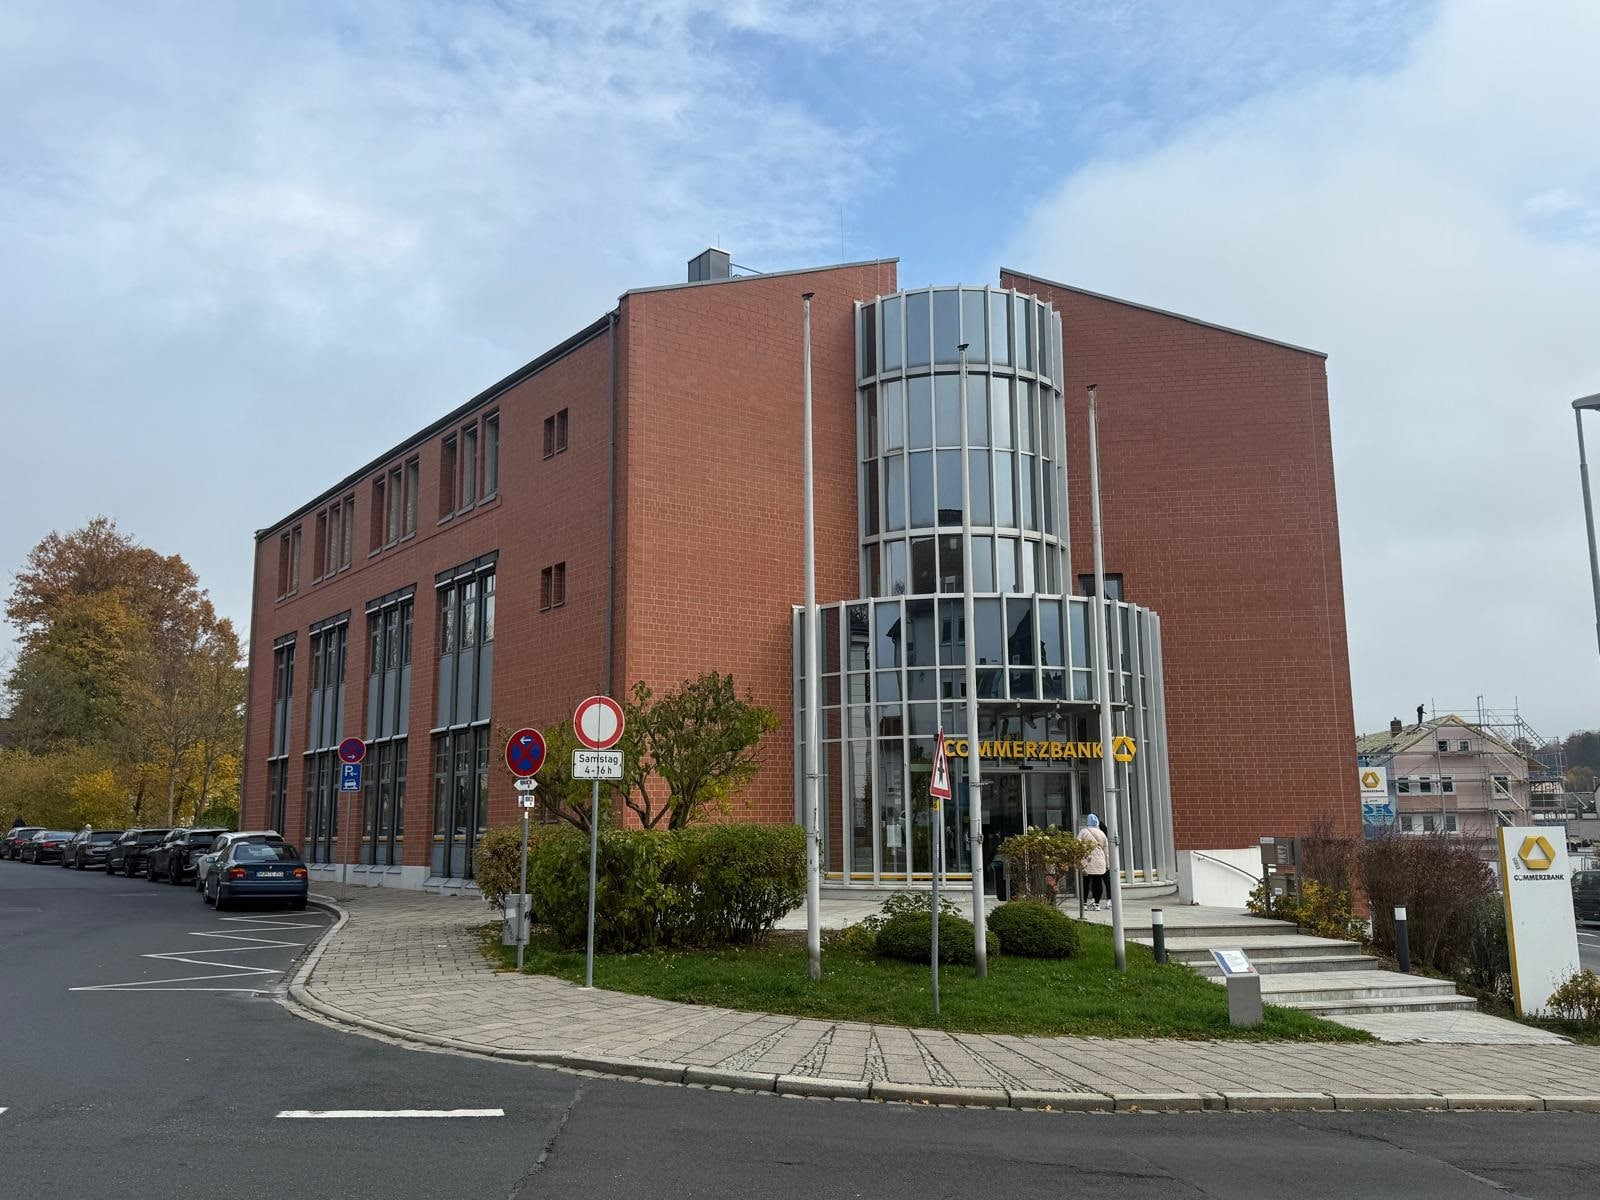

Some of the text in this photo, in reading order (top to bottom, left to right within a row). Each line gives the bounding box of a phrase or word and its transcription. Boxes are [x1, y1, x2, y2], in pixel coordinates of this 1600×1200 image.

[944, 739, 1103, 759] COMMERZBANK
[579, 754, 618, 765] Samstag
[345, 765, 353, 776] P
[607, 766, 612, 775] h
